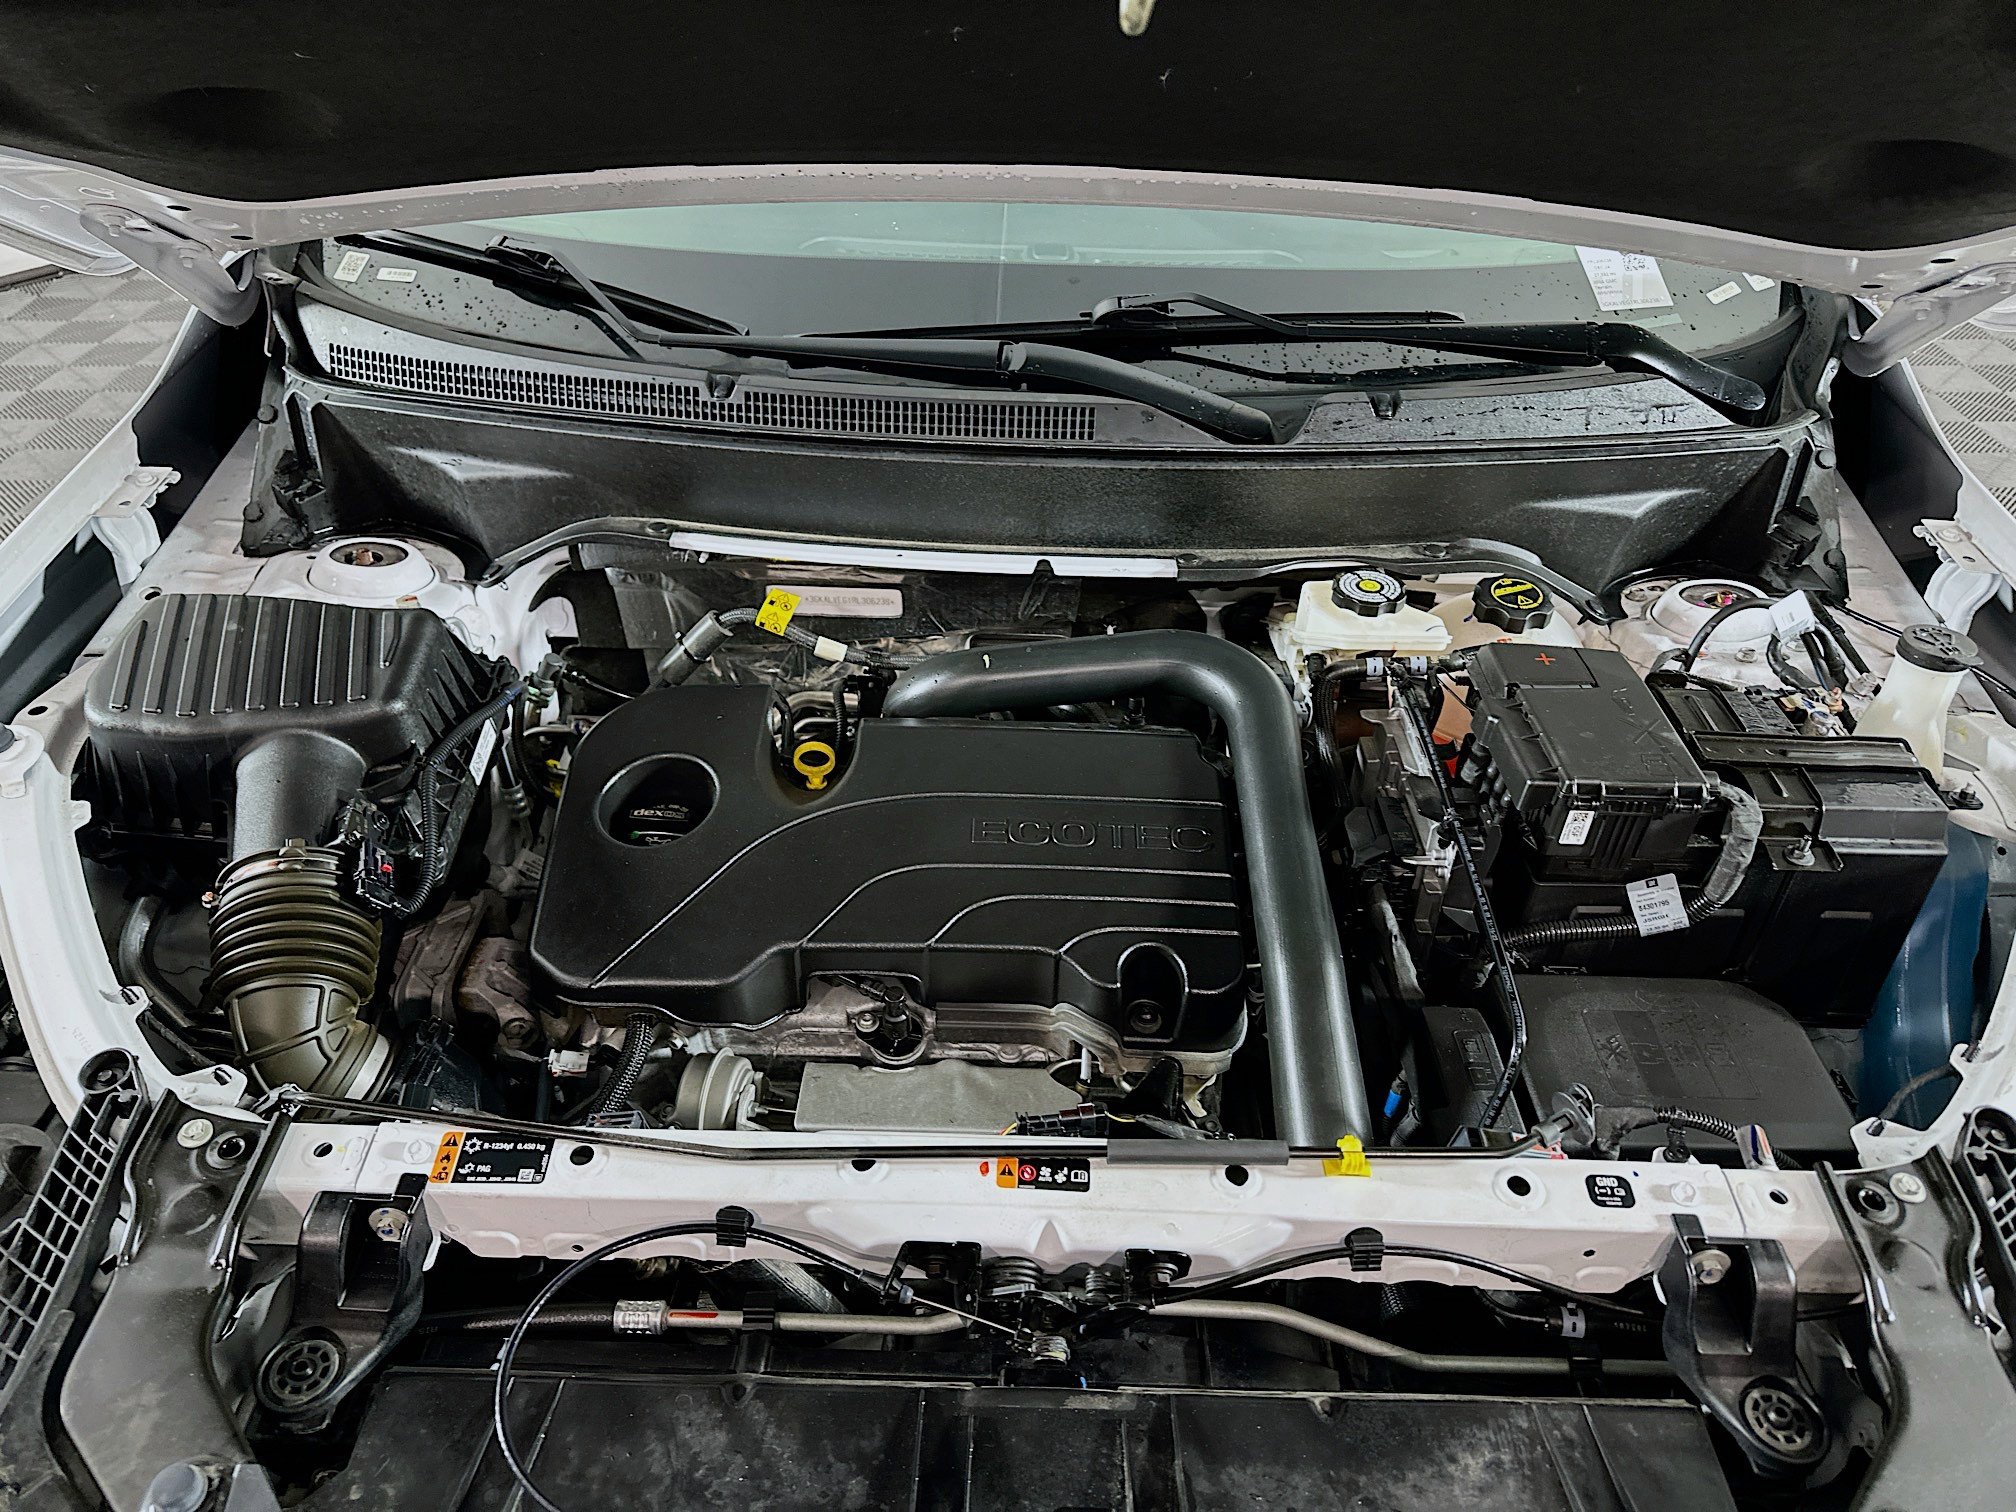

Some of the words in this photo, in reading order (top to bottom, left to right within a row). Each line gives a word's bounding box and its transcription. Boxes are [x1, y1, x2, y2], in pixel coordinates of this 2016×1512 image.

[971, 817, 1215, 853] ECOTEC
[475, 1164, 492, 1173] PAG
[1595, 1176, 1619, 1187] GND
